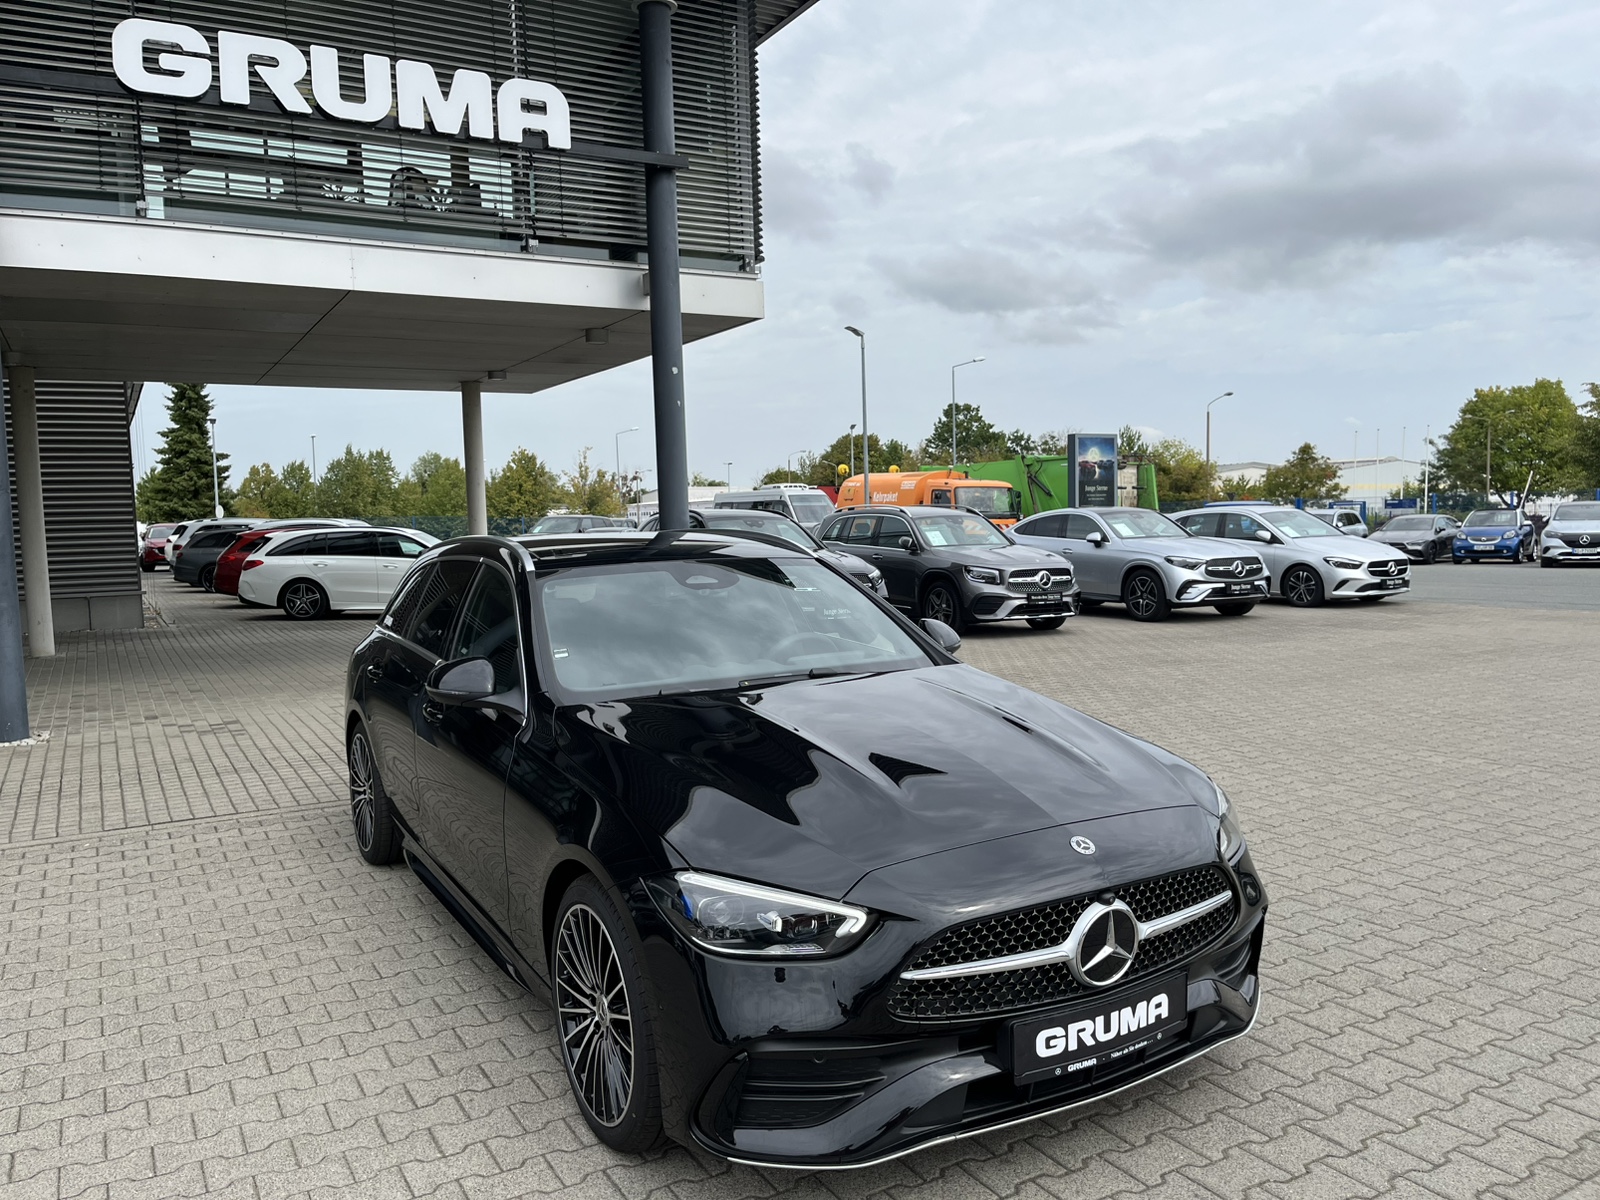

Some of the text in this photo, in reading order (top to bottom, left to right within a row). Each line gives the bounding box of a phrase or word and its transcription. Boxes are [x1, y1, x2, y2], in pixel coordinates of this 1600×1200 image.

[111, 17, 572, 150] GRUMA
[873, 492, 898, 503] Kehrpaket
[1035, 992, 1169, 1059] GRUMA
[1067, 1057, 1097, 1072] GRUMA
